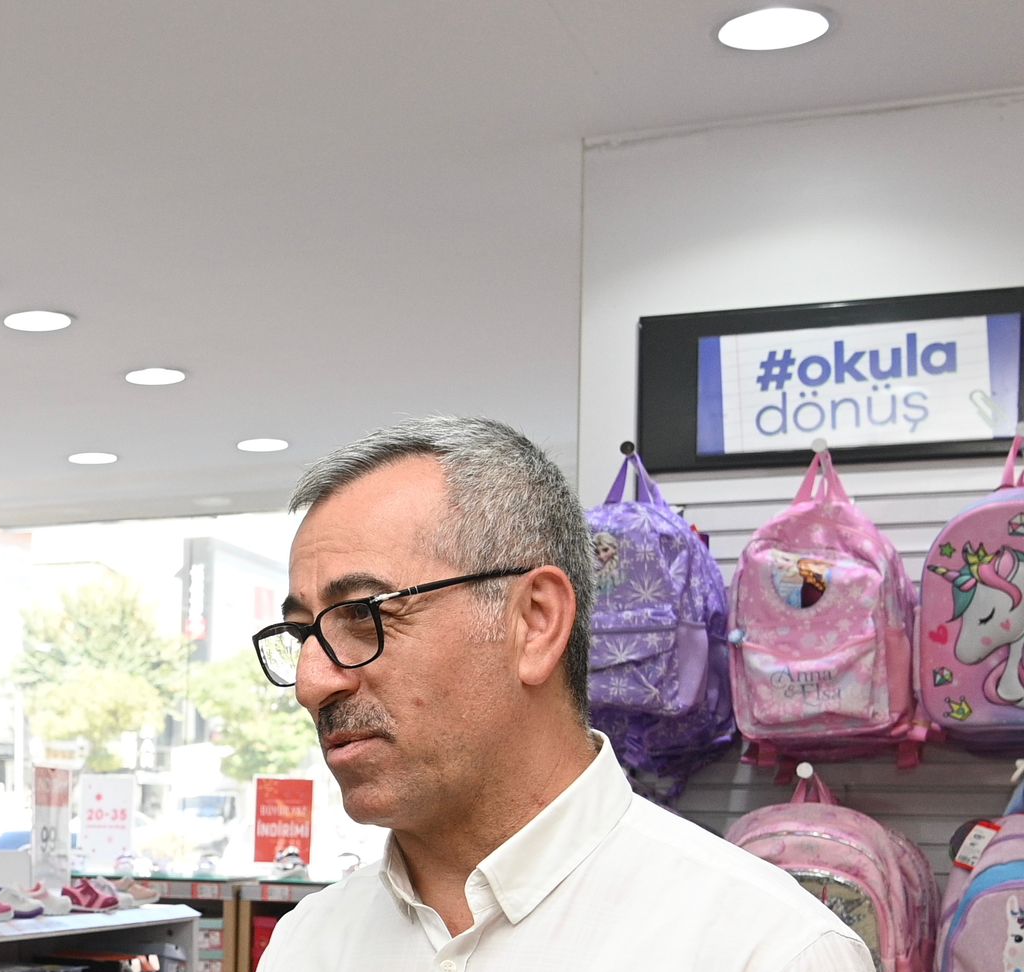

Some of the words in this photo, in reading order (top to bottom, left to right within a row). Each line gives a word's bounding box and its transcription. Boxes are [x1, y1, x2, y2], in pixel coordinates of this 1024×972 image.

[756, 332, 958, 391] #okula
[755, 384, 930, 437] dönüş
[771, 666, 833, 688] Anna
